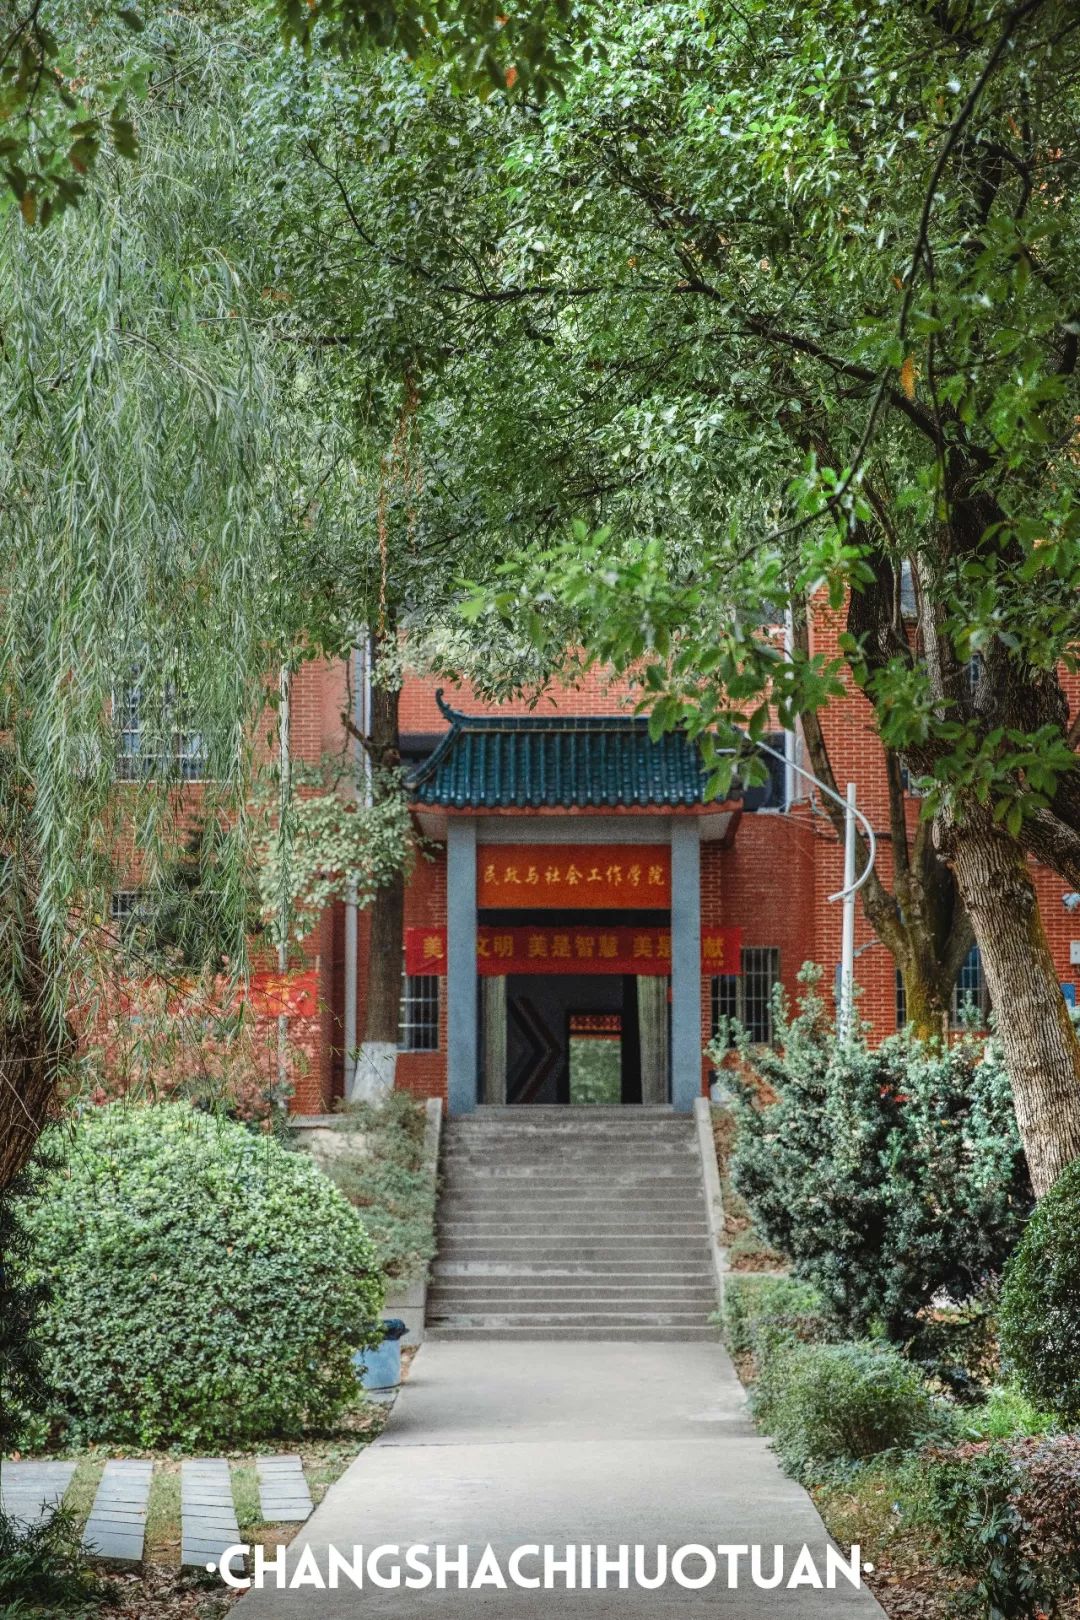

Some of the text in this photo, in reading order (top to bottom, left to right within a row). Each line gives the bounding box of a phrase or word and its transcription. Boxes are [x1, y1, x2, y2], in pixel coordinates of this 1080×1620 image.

[484, 864, 666, 886] 民政与社会工作学院
[423, 935, 724, 959] 美文明 美是智慧 美是献
